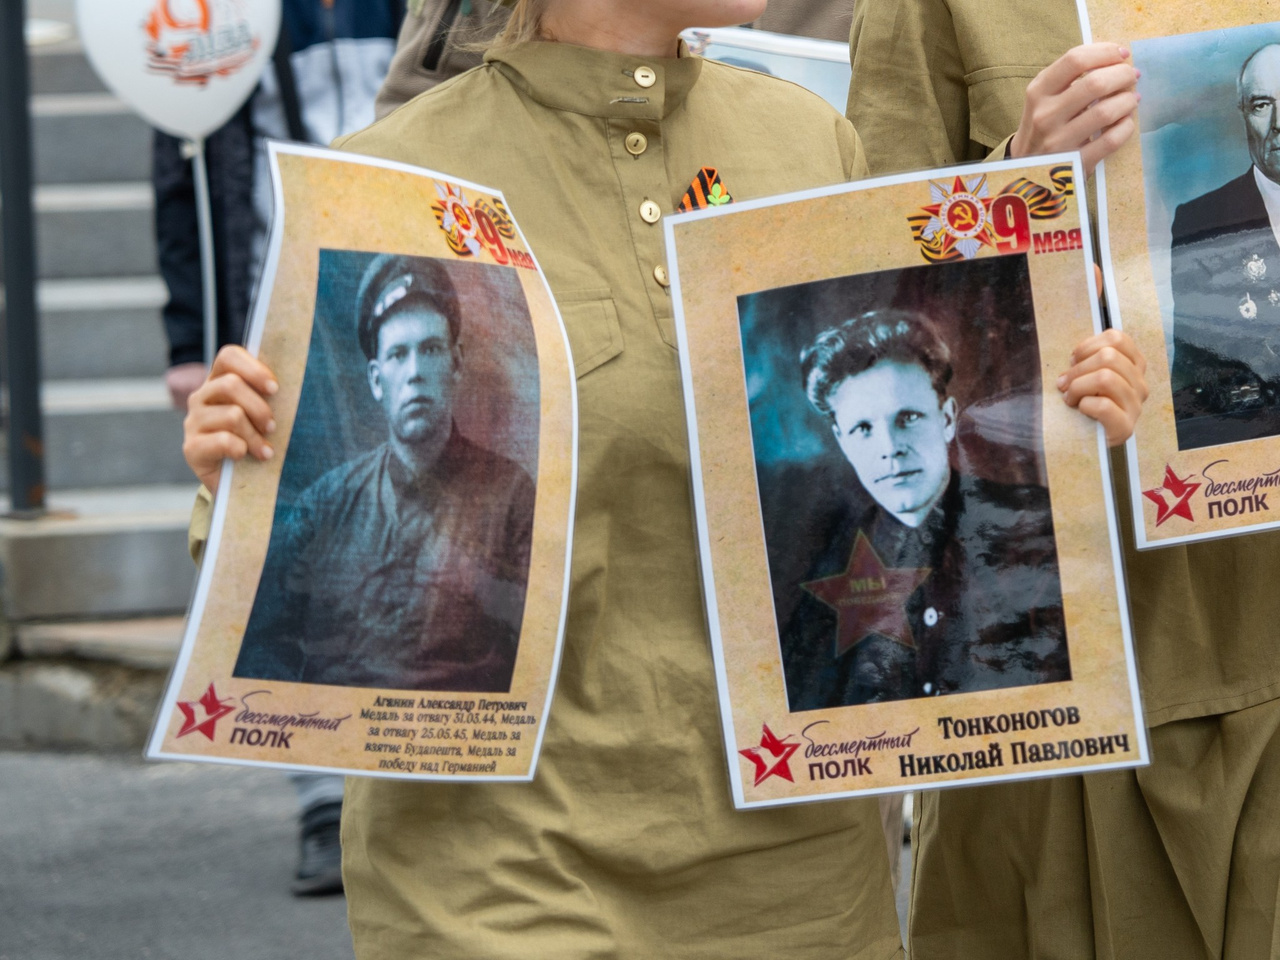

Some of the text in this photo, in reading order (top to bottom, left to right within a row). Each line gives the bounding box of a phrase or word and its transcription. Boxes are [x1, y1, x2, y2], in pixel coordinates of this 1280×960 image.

[991, 193, 1083, 255] 9 мая
[474, 209, 509, 265] 9
[1208, 493, 1270, 519] ПОЛК
[851, 576, 886, 592] МЫ
[234, 690, 352, 732] бессмертный
[360, 708, 400, 722] Медаль
[403, 712, 414, 722] за
[417, 712, 452, 725] отвагу
[501, 713, 537, 725] Медаль
[373, 695, 528, 715] Аганин Александр Петрович
[367, 725, 380, 737] за
[383, 727, 418, 740] отвагу
[473, 729, 508, 741] Медаль
[510, 731, 521, 741] за
[938, 705, 1081, 740] Тонконогов
[229, 727, 294, 749] ПОЛК
[364, 742, 402, 753] взятие
[467, 745, 503, 757] Медаль
[505, 747, 517, 757] за
[801, 720, 920, 759] бессмертный
[379, 758, 497, 773] победу над Германией
[899, 733, 1132, 778] Николай Павлович
[808, 757, 873, 781] ПОЛК
